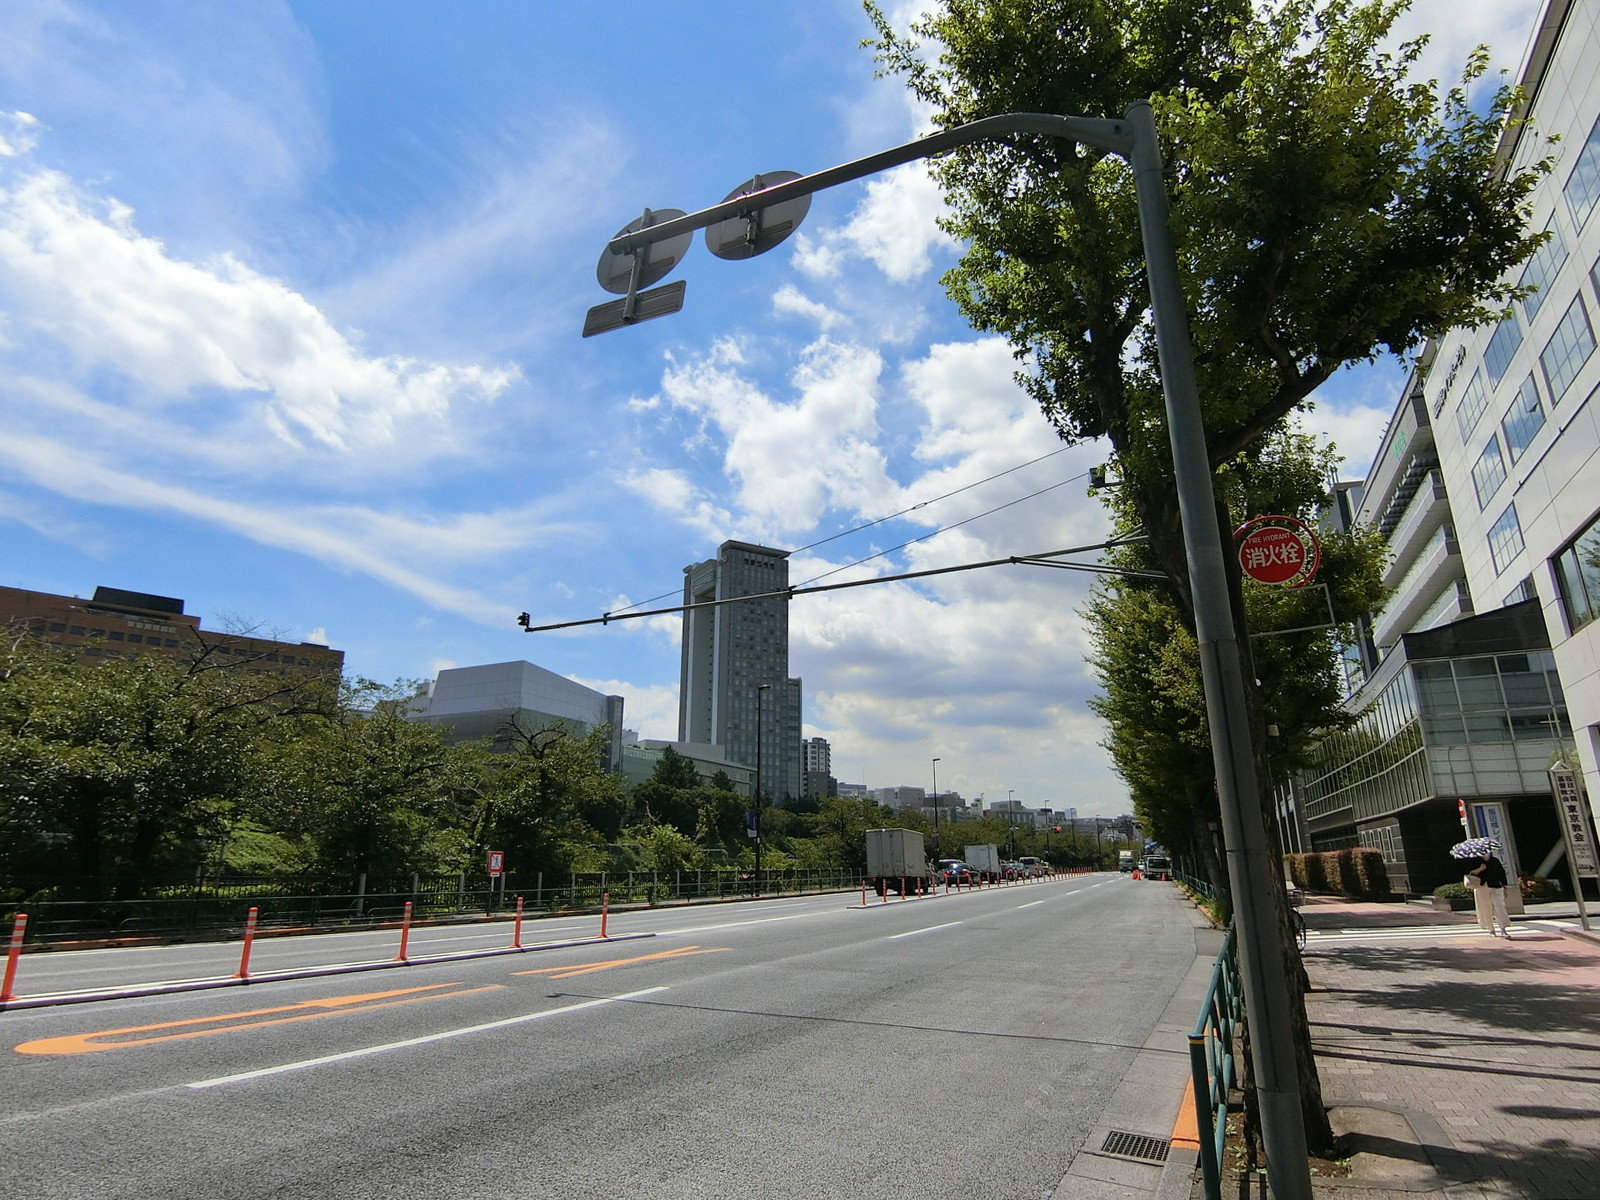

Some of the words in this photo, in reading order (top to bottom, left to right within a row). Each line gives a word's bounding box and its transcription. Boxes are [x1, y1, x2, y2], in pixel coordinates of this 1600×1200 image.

[1248, 536, 1261, 544] FIRE
[1263, 532, 1290, 543] HYDRANT
[1245, 541, 1301, 569] 消火栓
[1567, 805, 1584, 842] 東京教会
